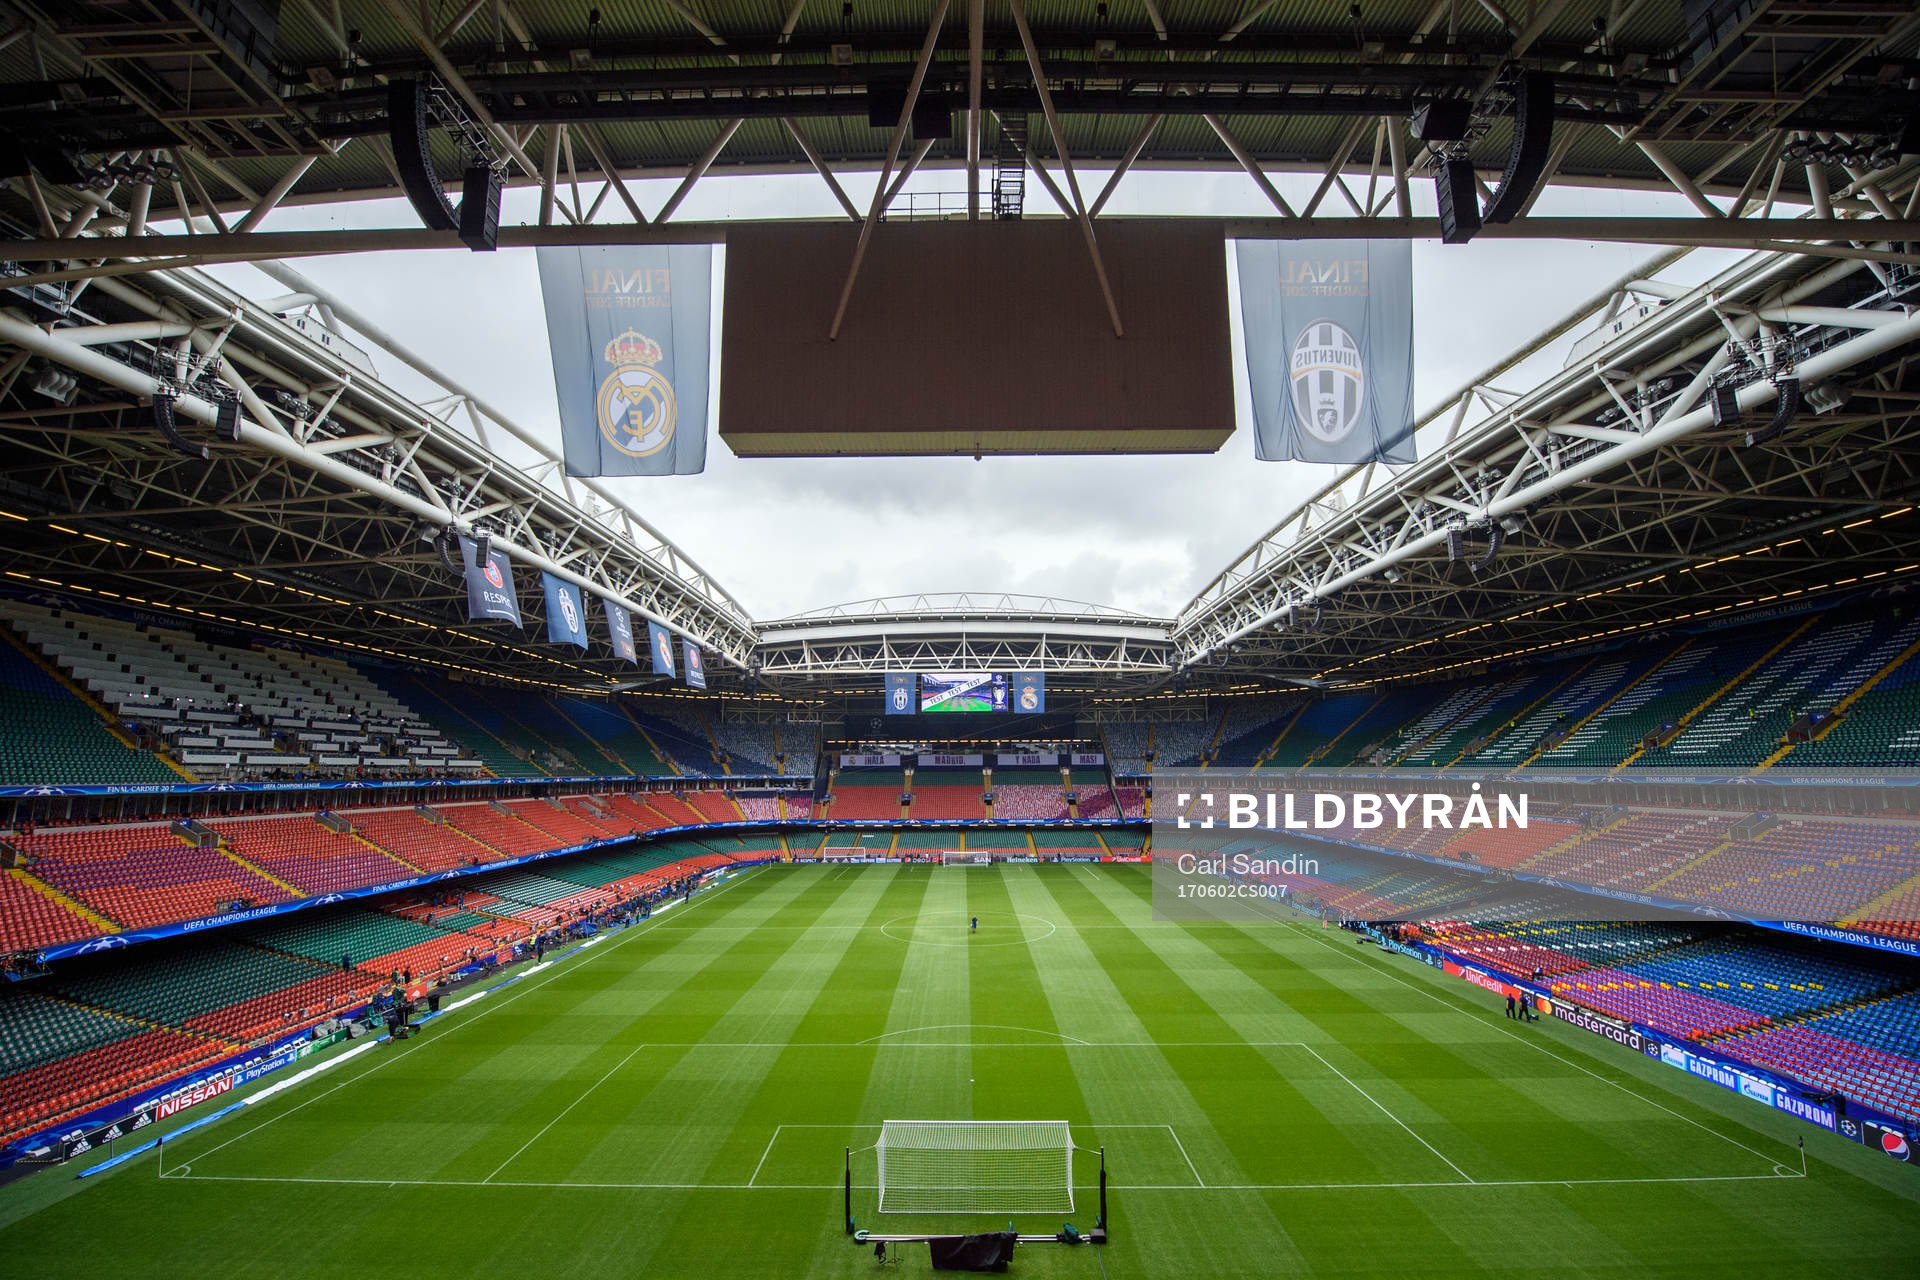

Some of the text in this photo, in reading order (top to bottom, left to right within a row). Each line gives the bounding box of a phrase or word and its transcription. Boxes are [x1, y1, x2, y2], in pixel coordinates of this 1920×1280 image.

[929, 678, 980, 705] TEST TEST TEST
[161, 785, 175, 793] 207
[183, 905, 278, 931] UEFA CHAMPIONS LEAGUE
[1388, 939, 1422, 961] PlayStation
[1783, 920, 1917, 953] UEFA CHAMPIONS LEAGUE
[1465, 969, 1504, 995] UniCredit
[1555, 1005, 1640, 1050] mastercard
[246, 1057, 285, 1081] PlayStation
[1689, 1058, 1735, 1089] GAZPROM
[160, 1080, 231, 1118] NISSAN
[1776, 1092, 1834, 1129] GAZPROM
